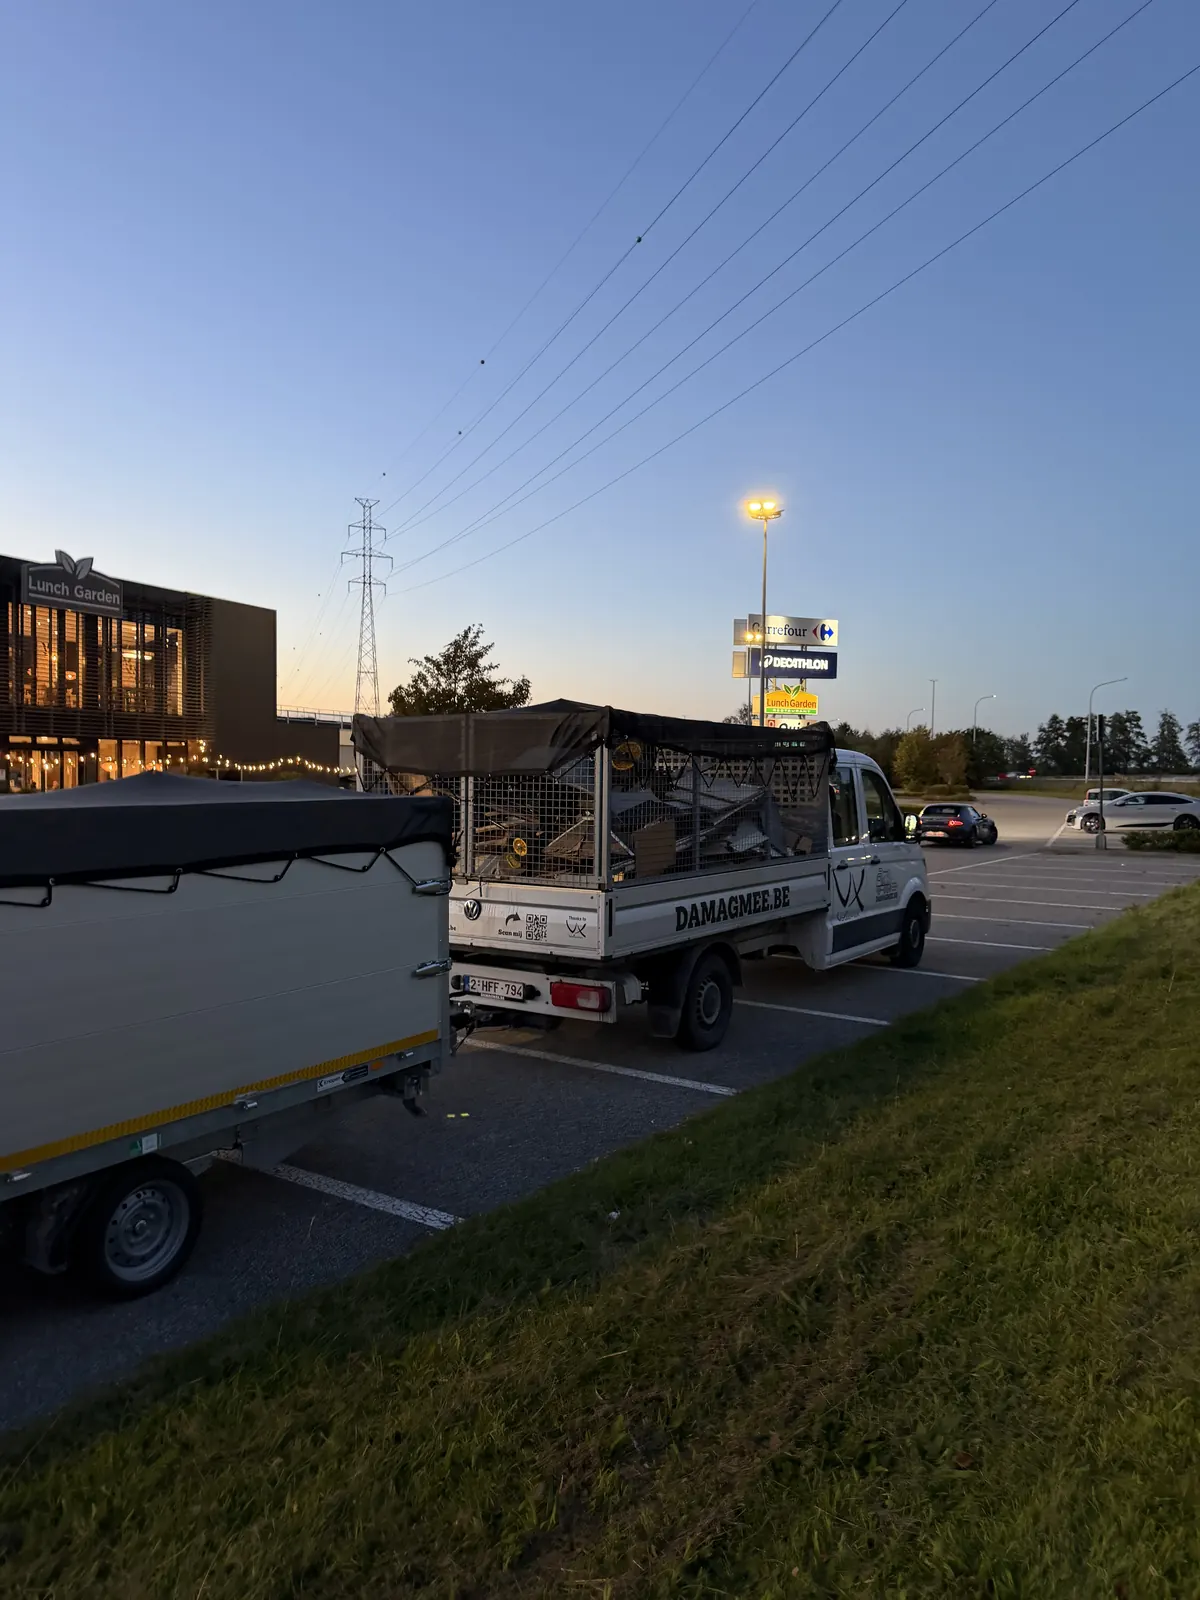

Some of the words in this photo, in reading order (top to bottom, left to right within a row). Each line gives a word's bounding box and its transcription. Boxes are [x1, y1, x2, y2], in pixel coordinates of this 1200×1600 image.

[28, 575, 69, 596] Lunch
[74, 585, 120, 605] Garden
[752, 622, 808, 637] Crrefour
[773, 657, 829, 670] DECATHLON
[766, 698, 789, 707] Lunch
[790, 699, 817, 709] Garden
[675, 885, 790, 932] DAMAGMEE.BE
[498, 929, 512, 937] Scan
